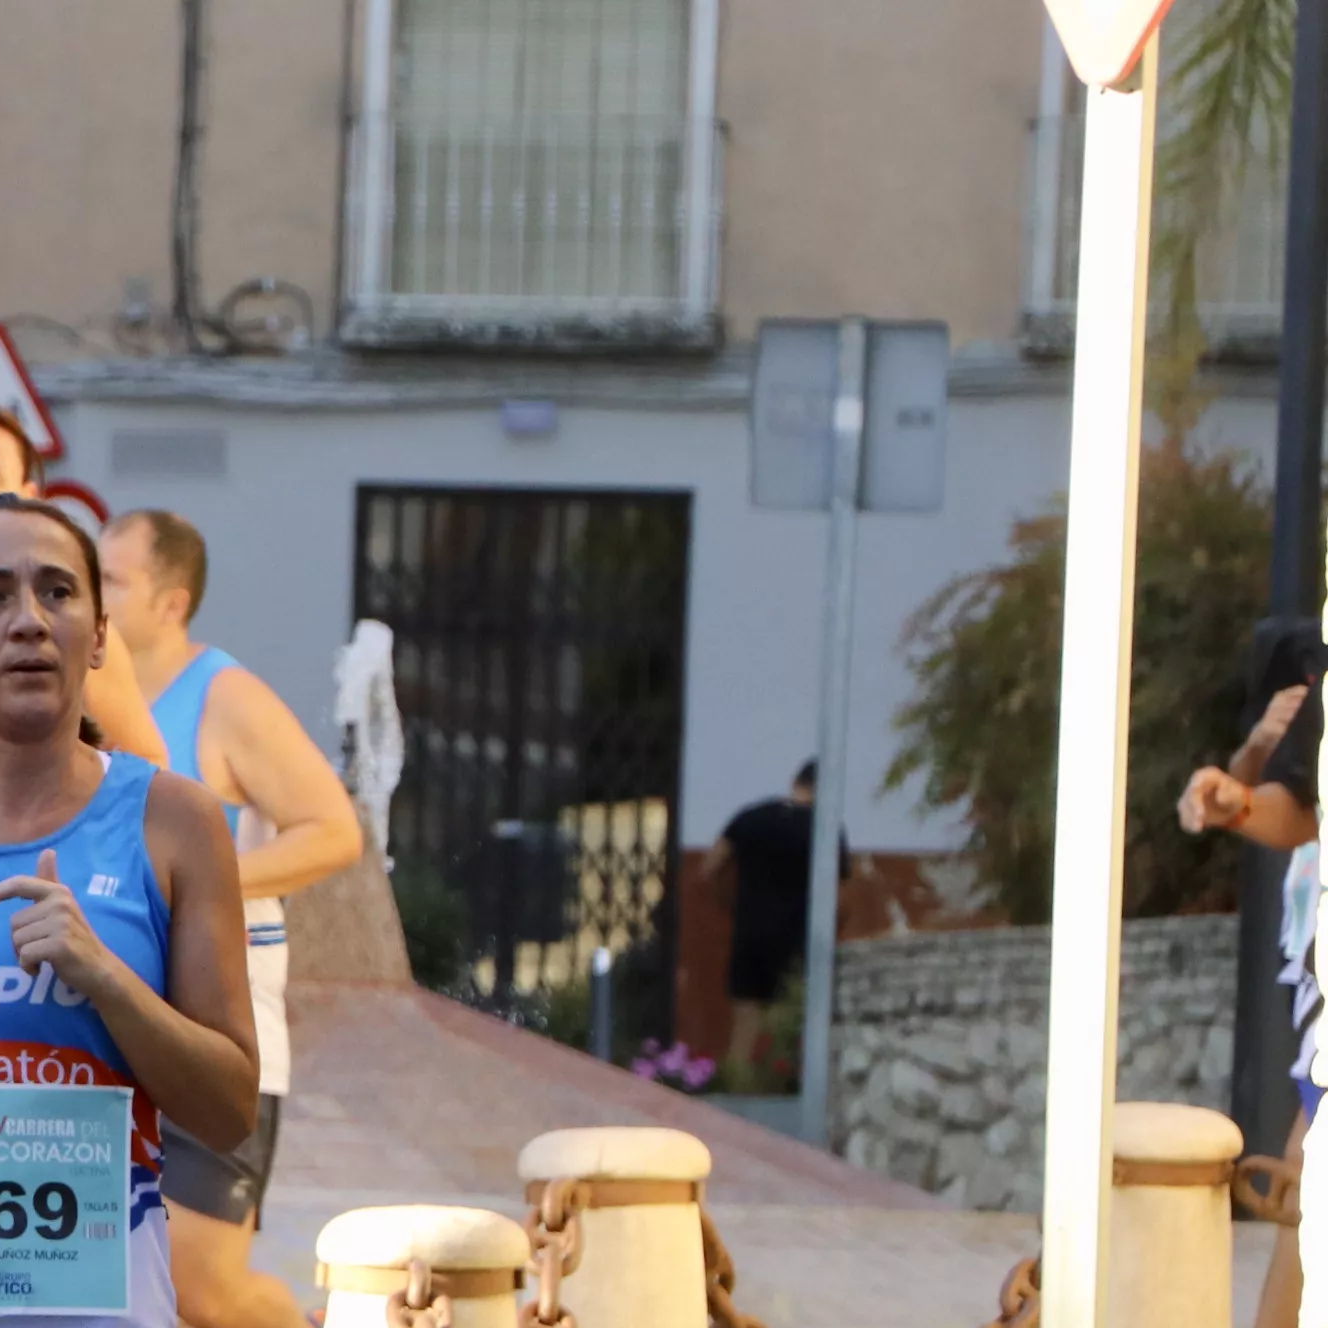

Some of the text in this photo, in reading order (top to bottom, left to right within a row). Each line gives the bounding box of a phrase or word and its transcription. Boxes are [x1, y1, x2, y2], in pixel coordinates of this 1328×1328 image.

[6, 1118, 75, 1137] CARRERA
[81, 1121, 110, 1139] DEL
[34, 1248, 79, 1260] MUÑOZ
